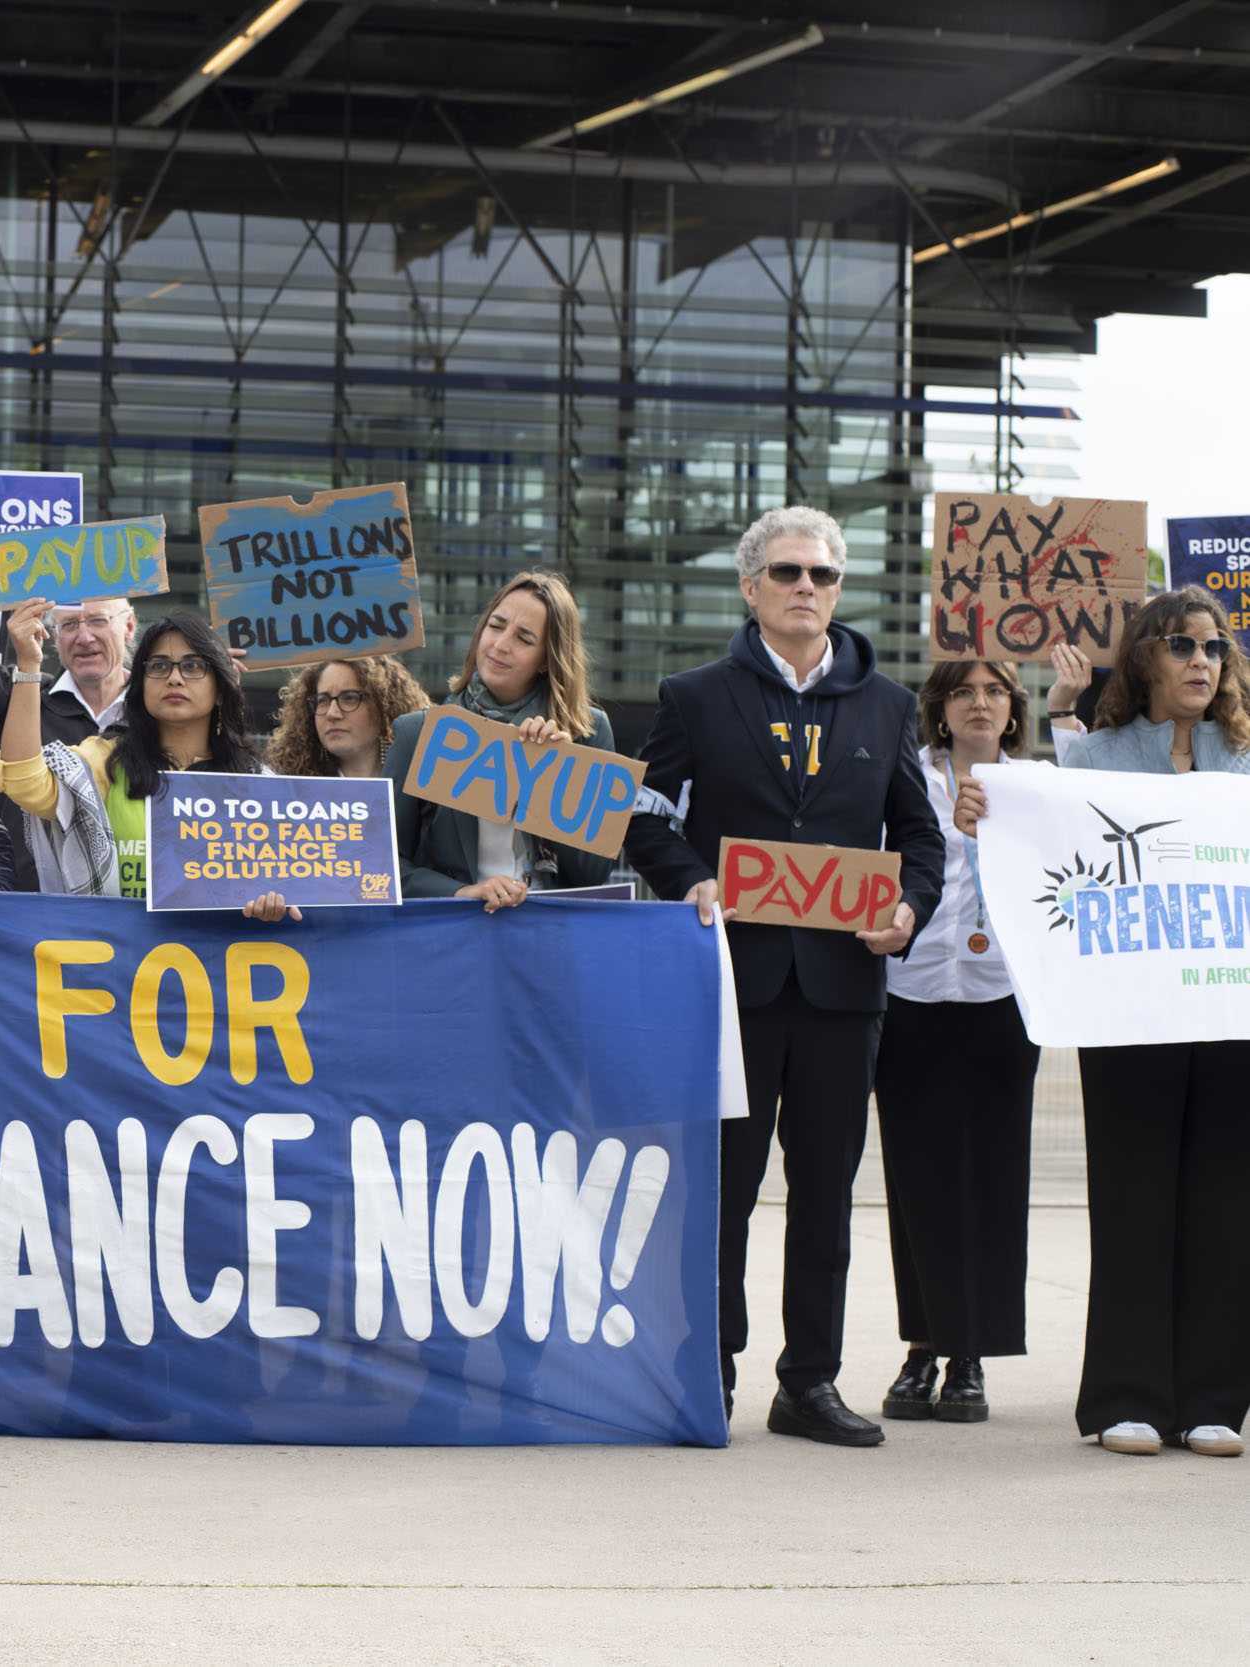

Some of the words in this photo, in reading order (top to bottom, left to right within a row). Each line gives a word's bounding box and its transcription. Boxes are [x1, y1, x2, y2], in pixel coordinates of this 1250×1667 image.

[93, 527, 159, 583] UP
[219, 516, 414, 573] TRILLIONS
[946, 501, 1064, 557] PAY
[271, 566, 360, 605] NOT
[940, 549, 1114, 602] WHAT
[228, 602, 408, 649] BILLIONS
[418, 716, 558, 824] PAY
[550, 756, 637, 843] UP
[173, 797, 216, 818] NO
[223, 799, 262, 819] TO
[271, 800, 369, 820] LOANS
[180, 821, 223, 840] NO
[230, 822, 269, 840] TO
[277, 823, 364, 841] FALSE
[183, 860, 362, 880] SOLUTIONS!
[207, 842, 338, 860] FINANCE
[724, 844, 842, 919] PAY
[830, 872, 897, 930] UP
[1182, 967, 1199, 986] IN
[34, 940, 315, 1086] FOR
[350, 1115, 670, 1347] NOW!
